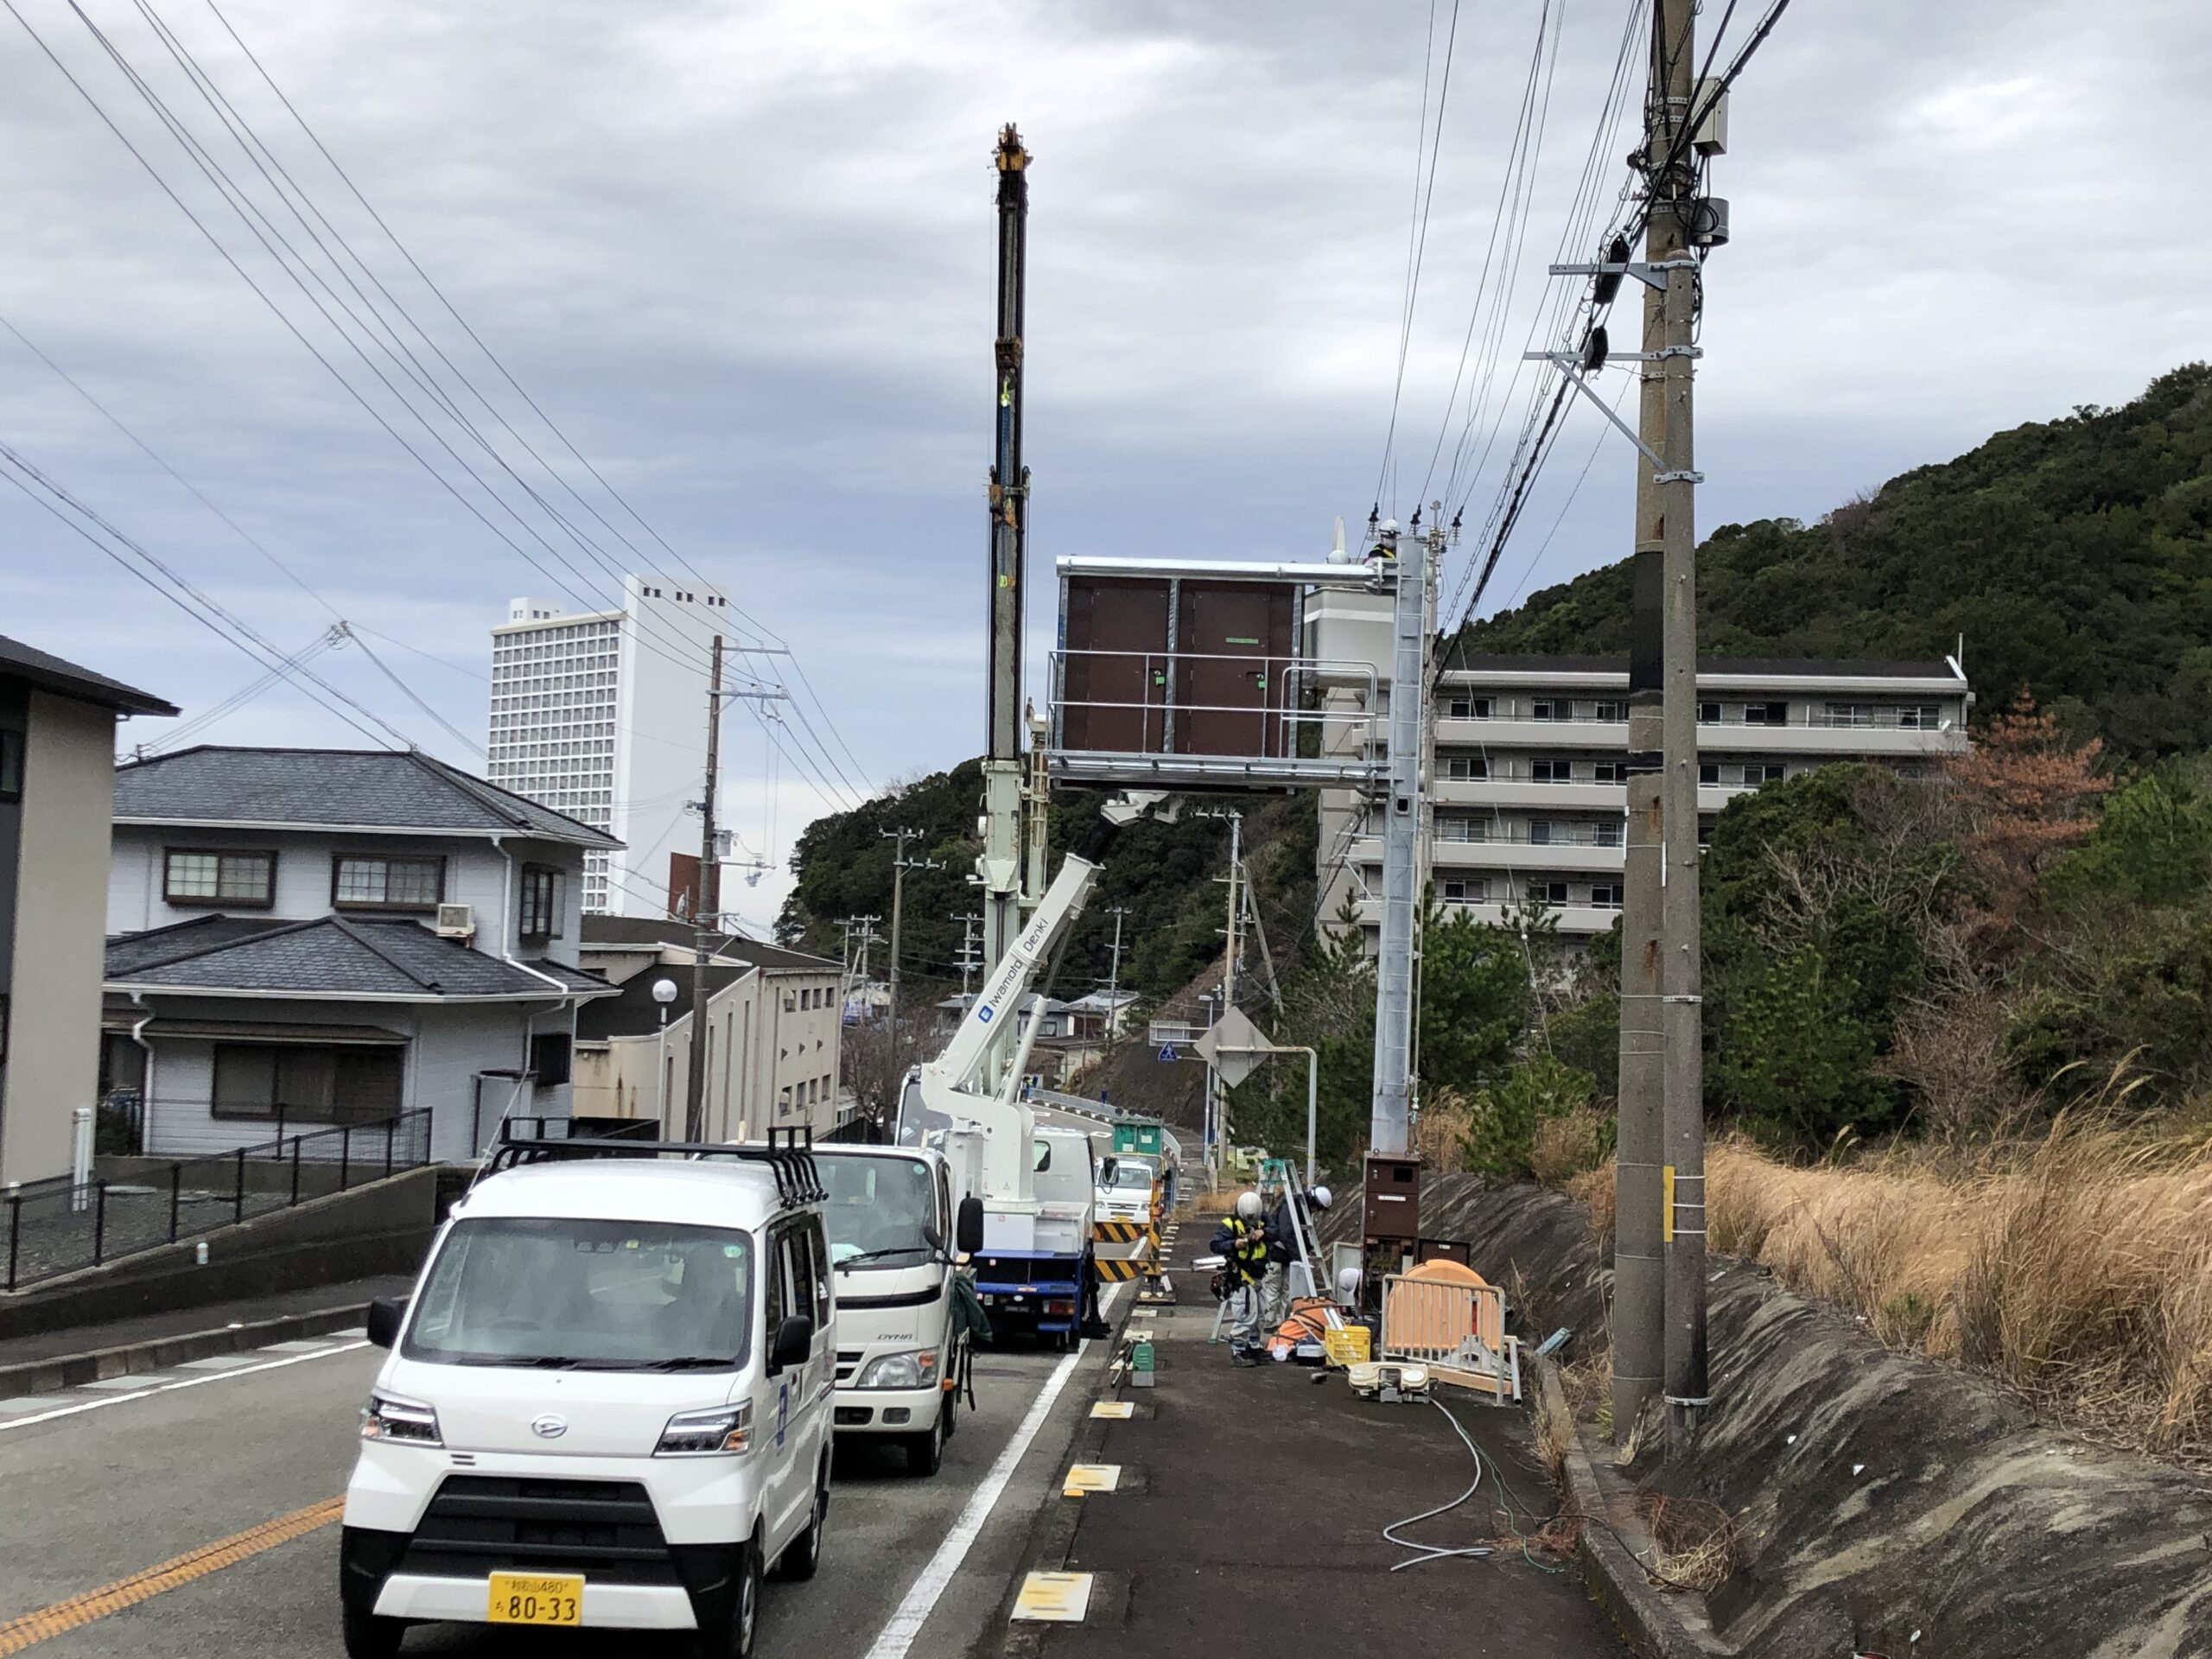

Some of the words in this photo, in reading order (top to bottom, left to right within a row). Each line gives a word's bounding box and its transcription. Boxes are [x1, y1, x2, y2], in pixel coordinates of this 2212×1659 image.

[988, 958, 1024, 1008] Iwamoto
[1023, 918, 1049, 952] Denki
[508, 1595, 576, 1621] 80-33
